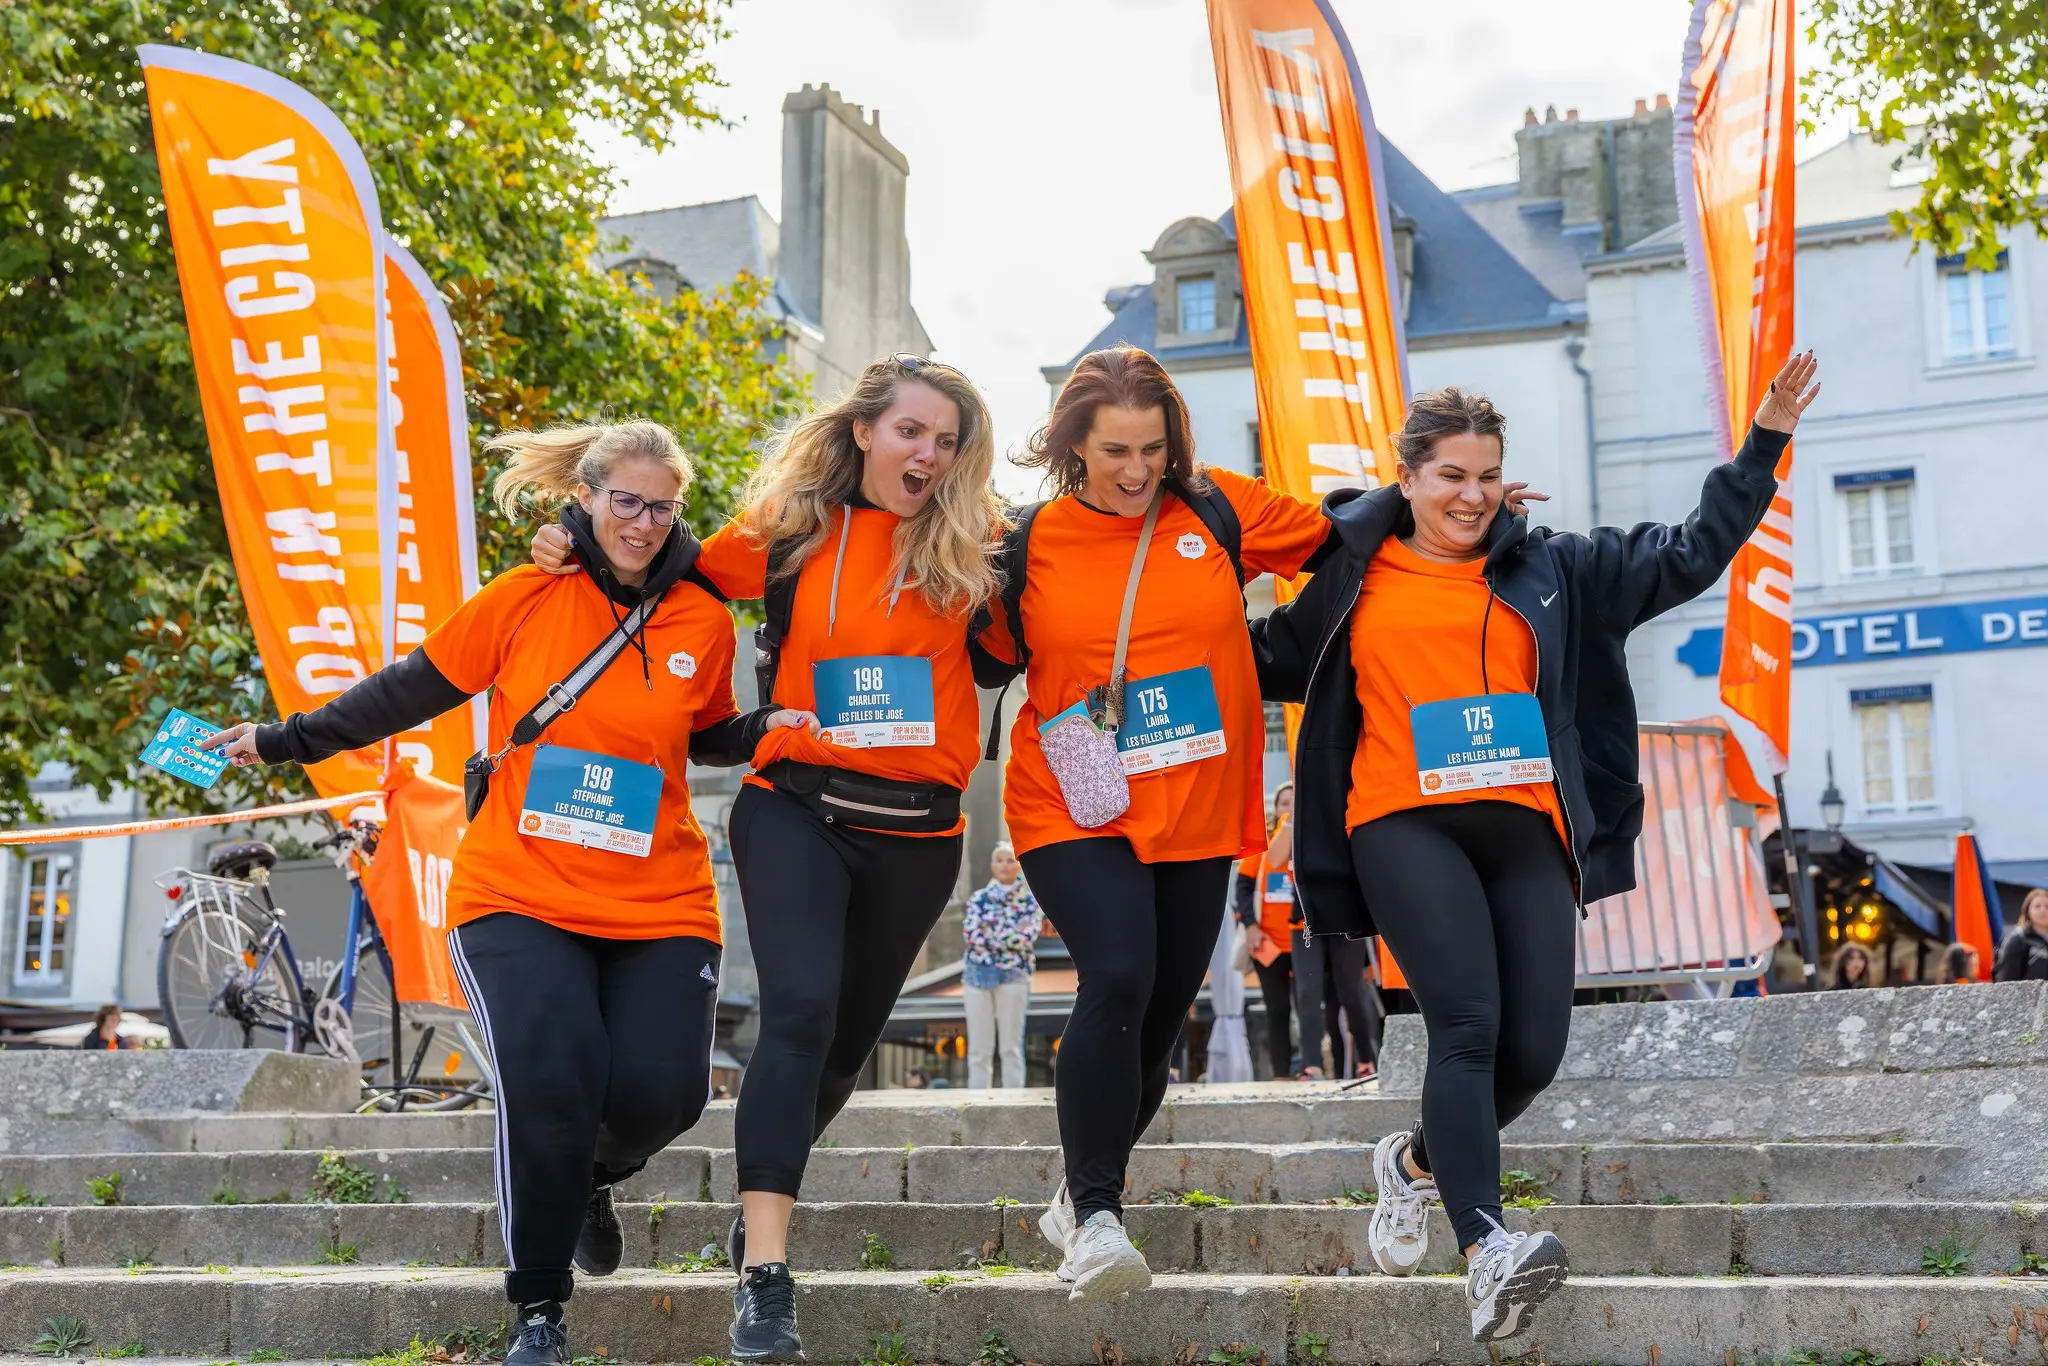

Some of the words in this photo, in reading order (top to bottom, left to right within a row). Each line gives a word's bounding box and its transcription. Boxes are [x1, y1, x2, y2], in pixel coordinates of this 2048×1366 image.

[1791, 612, 1944, 661] OTEL
[1982, 608, 2048, 643] DE
[853, 667, 883, 692] 198
[848, 694, 890, 707] CHARLOTTE
[1137, 686, 1169, 714] 175
[838, 712, 849, 723] LES
[850, 710, 873, 722] FILLES
[875, 710, 884, 720] DE
[1145, 714, 1170, 728] LAURA
[1462, 706, 1494, 732] 175
[1126, 736, 1140, 748] LES
[1140, 731, 1164, 745] FILLES
[1164, 729, 1174, 740] DE
[1175, 724, 1196, 737] MANU
[1186, 740, 1196, 750] POP
[1197, 739, 1202, 747] IN
[1471, 734, 1493, 746] JULIE
[1447, 754, 1460, 764] LES
[1462, 750, 1486, 763] FILLES
[1488, 749, 1497, 759] DE
[1499, 746, 1520, 758] MANU
[1511, 764, 1521, 772] POP
[1521, 763, 1527, 771] IN
[582, 763, 614, 792] 198
[554, 802, 569, 814] LES
[570, 804, 594, 820] FILLES
[595, 810, 606, 822] DE
[609, 830, 621, 840] POP
[622, 832, 627, 841] IN
